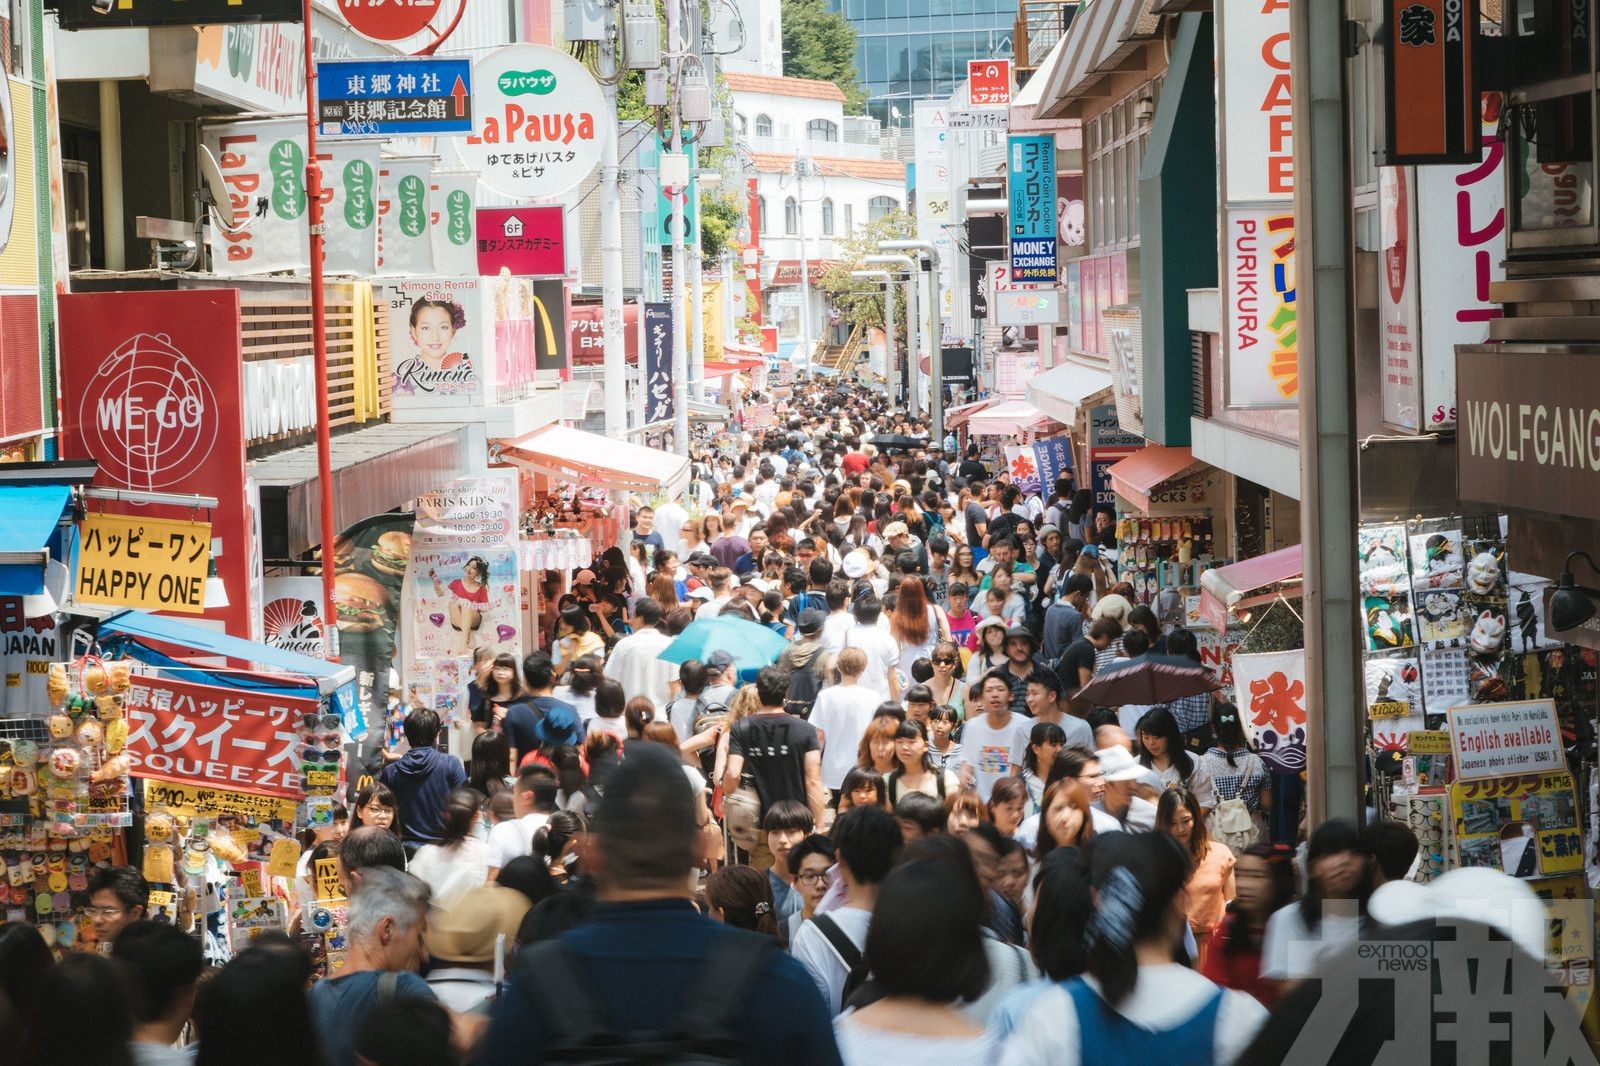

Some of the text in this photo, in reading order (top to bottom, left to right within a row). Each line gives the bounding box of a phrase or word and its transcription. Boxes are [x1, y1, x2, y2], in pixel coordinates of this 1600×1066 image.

[346, 73, 442, 95] 東郷神社
[499, 75, 554, 89] ラパウザ
[346, 99, 447, 121] 東郷記念館
[980, 93, 1009, 103] アガサ
[505, 103, 594, 145] Pausa
[487, 151, 576, 166] ゆであげパスタ
[279, 143, 300, 218] ラパウザ
[351, 162, 367, 228] ラパウザ
[1025, 142, 1040, 234] コインロッカー
[1042, 142, 1052, 234] Rental Coin Locker
[405, 178, 419, 235] ラパウザ
[453, 191, 466, 244] ラパウザ
[507, 224, 520, 234] 6F
[1013, 241, 1054, 255] MONEY
[1013, 256, 1056, 267] EXCHANGE
[400, 280, 477, 291] Kimono Rental
[425, 291, 453, 302] Shop
[1236, 219, 1258, 350] PURIKURA
[391, 300, 406, 308] 3F
[397, 359, 475, 392] Kimono
[98, 397, 144, 431] WE
[1466, 400, 1600, 472] WOLFGANG
[416, 495, 495, 508] PARIS KID'S
[84, 527, 205, 564] ハッピーワン
[80, 566, 201, 606] HAPPY ONE
[3, 635, 55, 657] JAPAN
[127, 685, 304, 729] 原宿ハッピーワン
[1250, 671, 1307, 735] 氷
[1459, 725, 1552, 753] English available
[128, 750, 302, 789] SQUEEZE
[1461, 758, 1487, 770] Japanese
[1489, 755, 1505, 768] photo
[1541, 832, 1582, 858] ご案内
